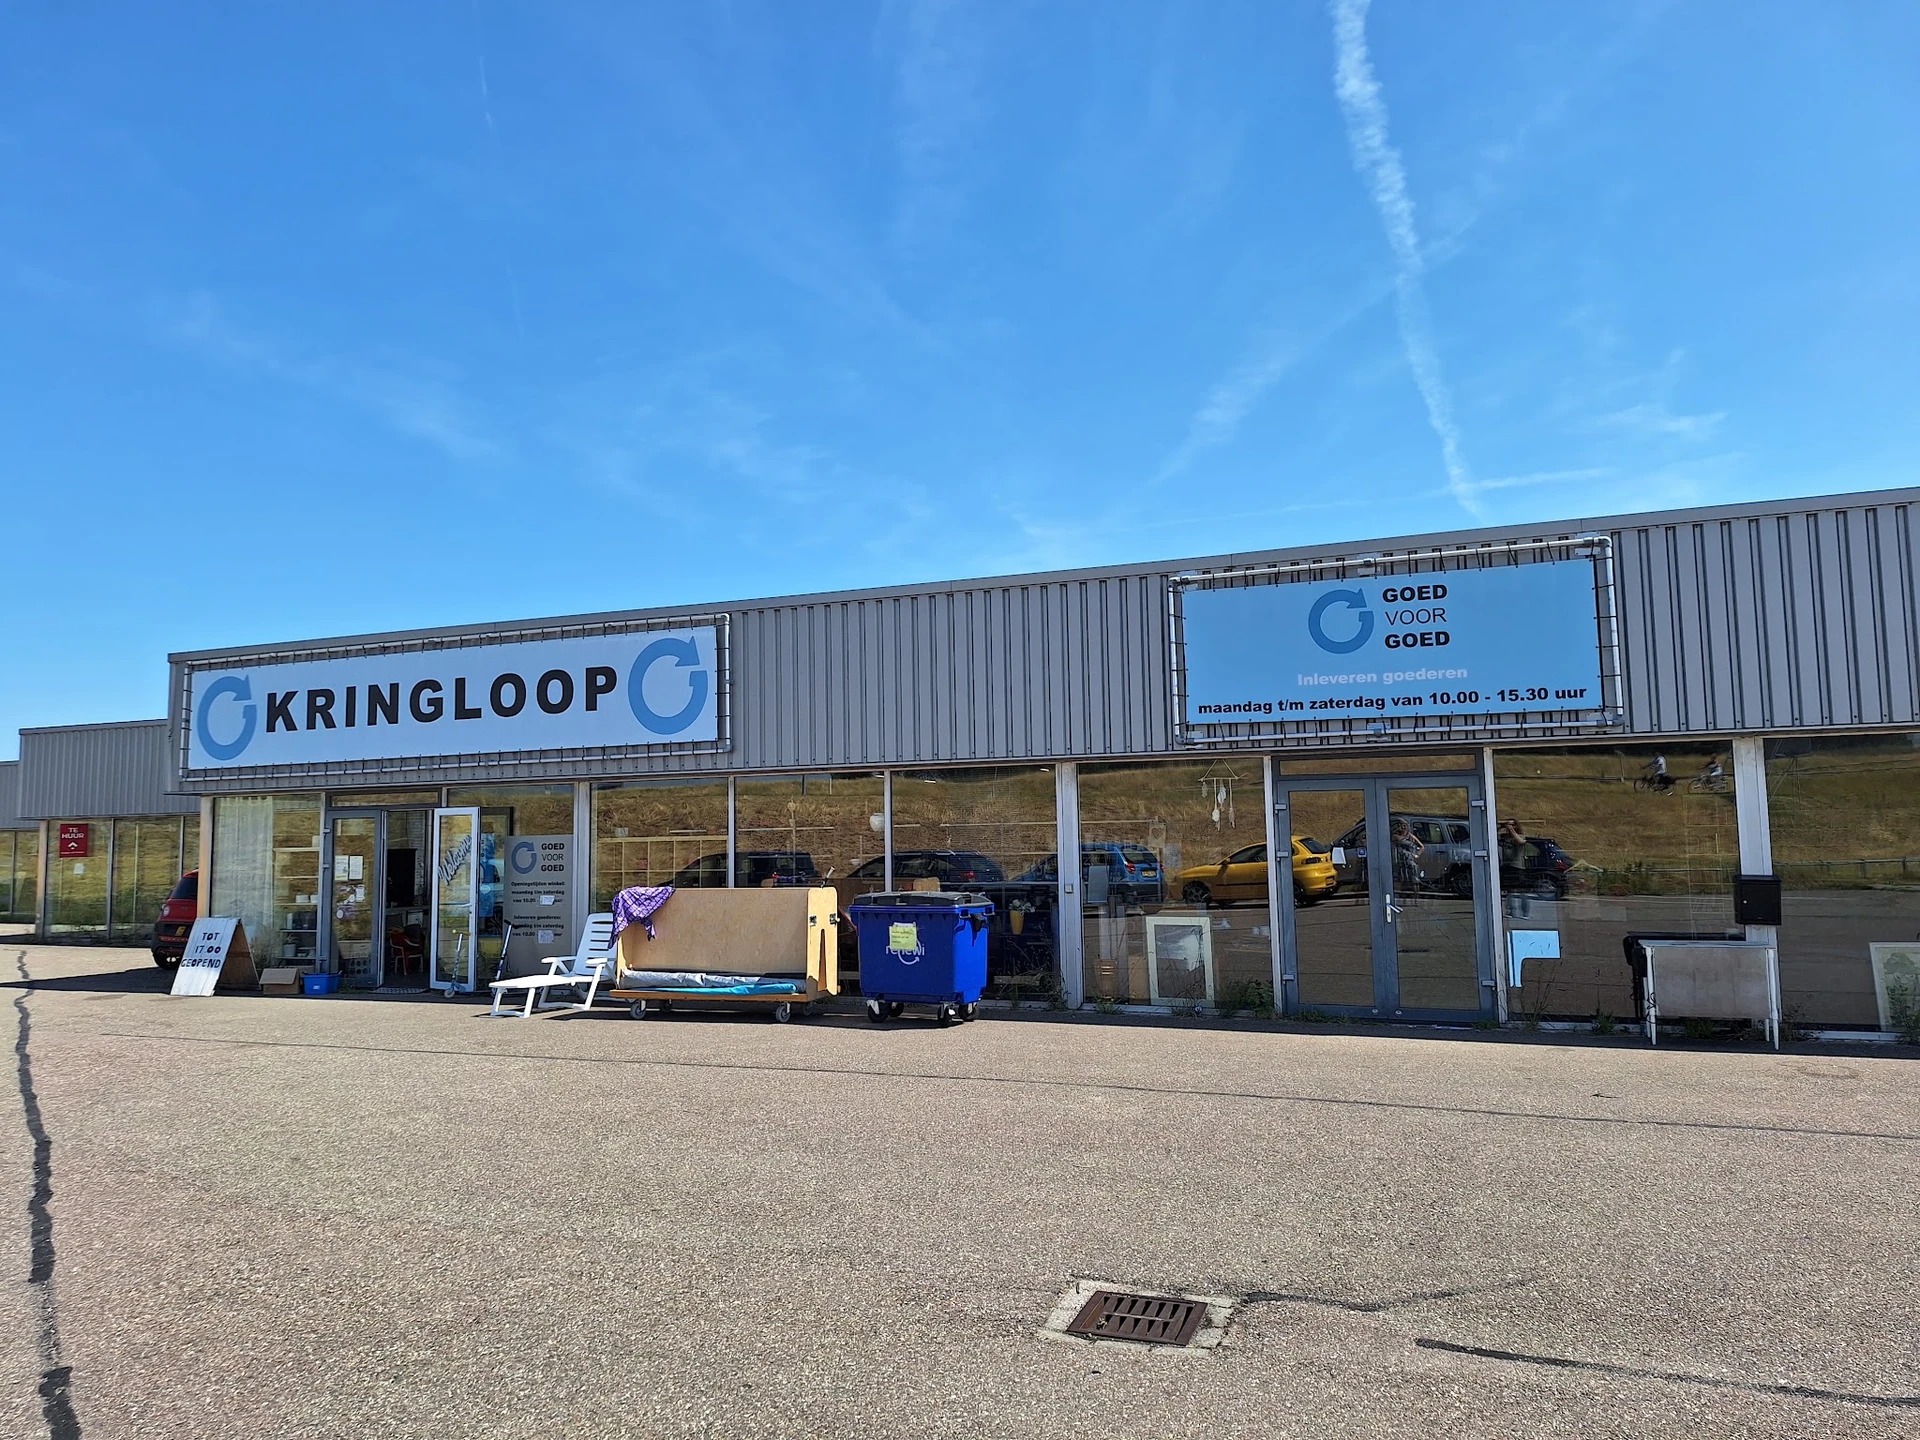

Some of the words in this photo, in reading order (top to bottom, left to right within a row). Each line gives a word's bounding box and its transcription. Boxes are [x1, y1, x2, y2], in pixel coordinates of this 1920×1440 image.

[1382, 584, 1448, 603] GOED
[1385, 607, 1447, 626] VOOR
[1384, 631, 1450, 649] GOED
[1298, 672, 1377, 686] Inleveren
[1383, 667, 1468, 685] goederen
[266, 666, 617, 733] KRINGLOOP
[1198, 701, 1272, 715] maandag
[1278, 699, 1304, 712] t/m
[1309, 696, 1386, 711] zaterdag
[1391, 695, 1423, 707] van
[1429, 690, 1480, 705] 10.00
[1497, 687, 1549, 702] 15.30
[1555, 687, 1588, 700] uur
[540, 864, 565, 872] GOED
[203, 932, 220, 940] TOT
[180, 958, 221, 968] GEOPEND
